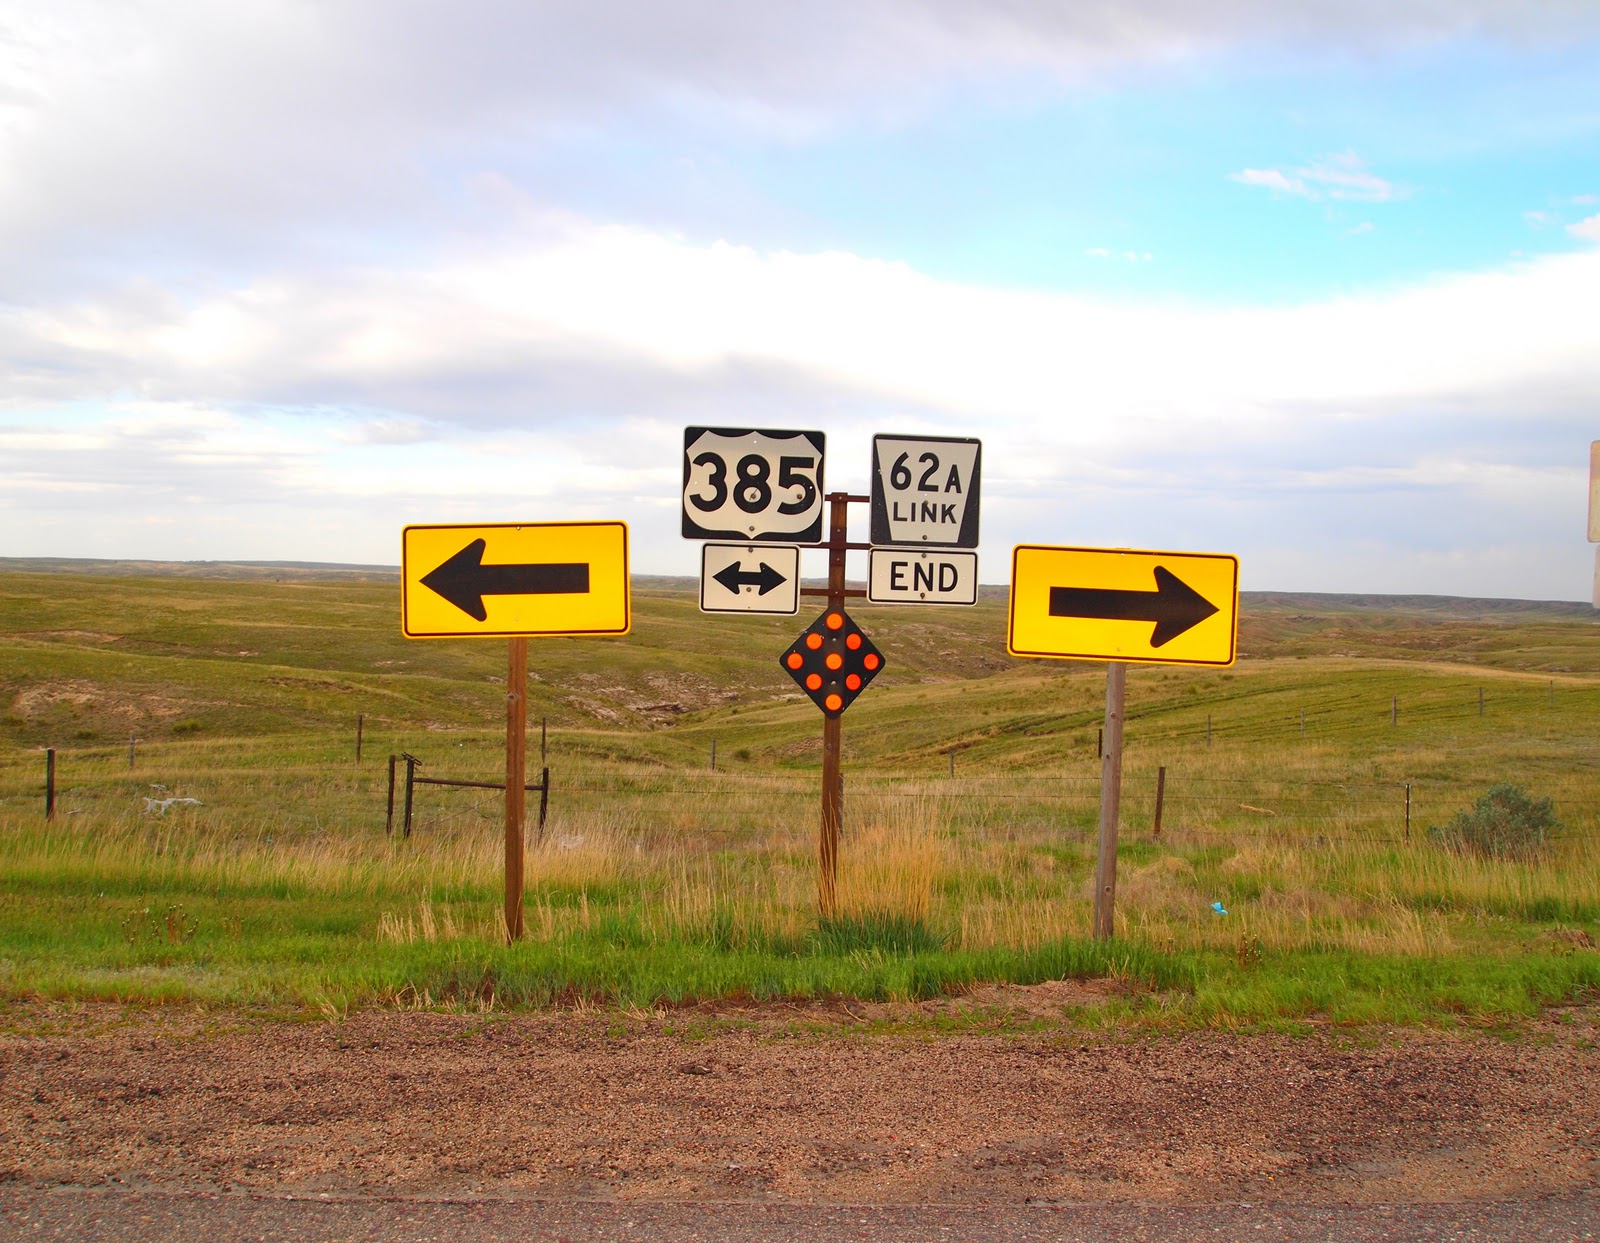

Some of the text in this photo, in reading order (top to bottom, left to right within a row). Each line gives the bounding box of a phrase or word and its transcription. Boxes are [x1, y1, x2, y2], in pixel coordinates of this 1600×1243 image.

[689, 452, 816, 515] 385
[890, 451, 962, 494] 62A
[893, 501, 957, 524] LINK
[890, 561, 958, 592] END
